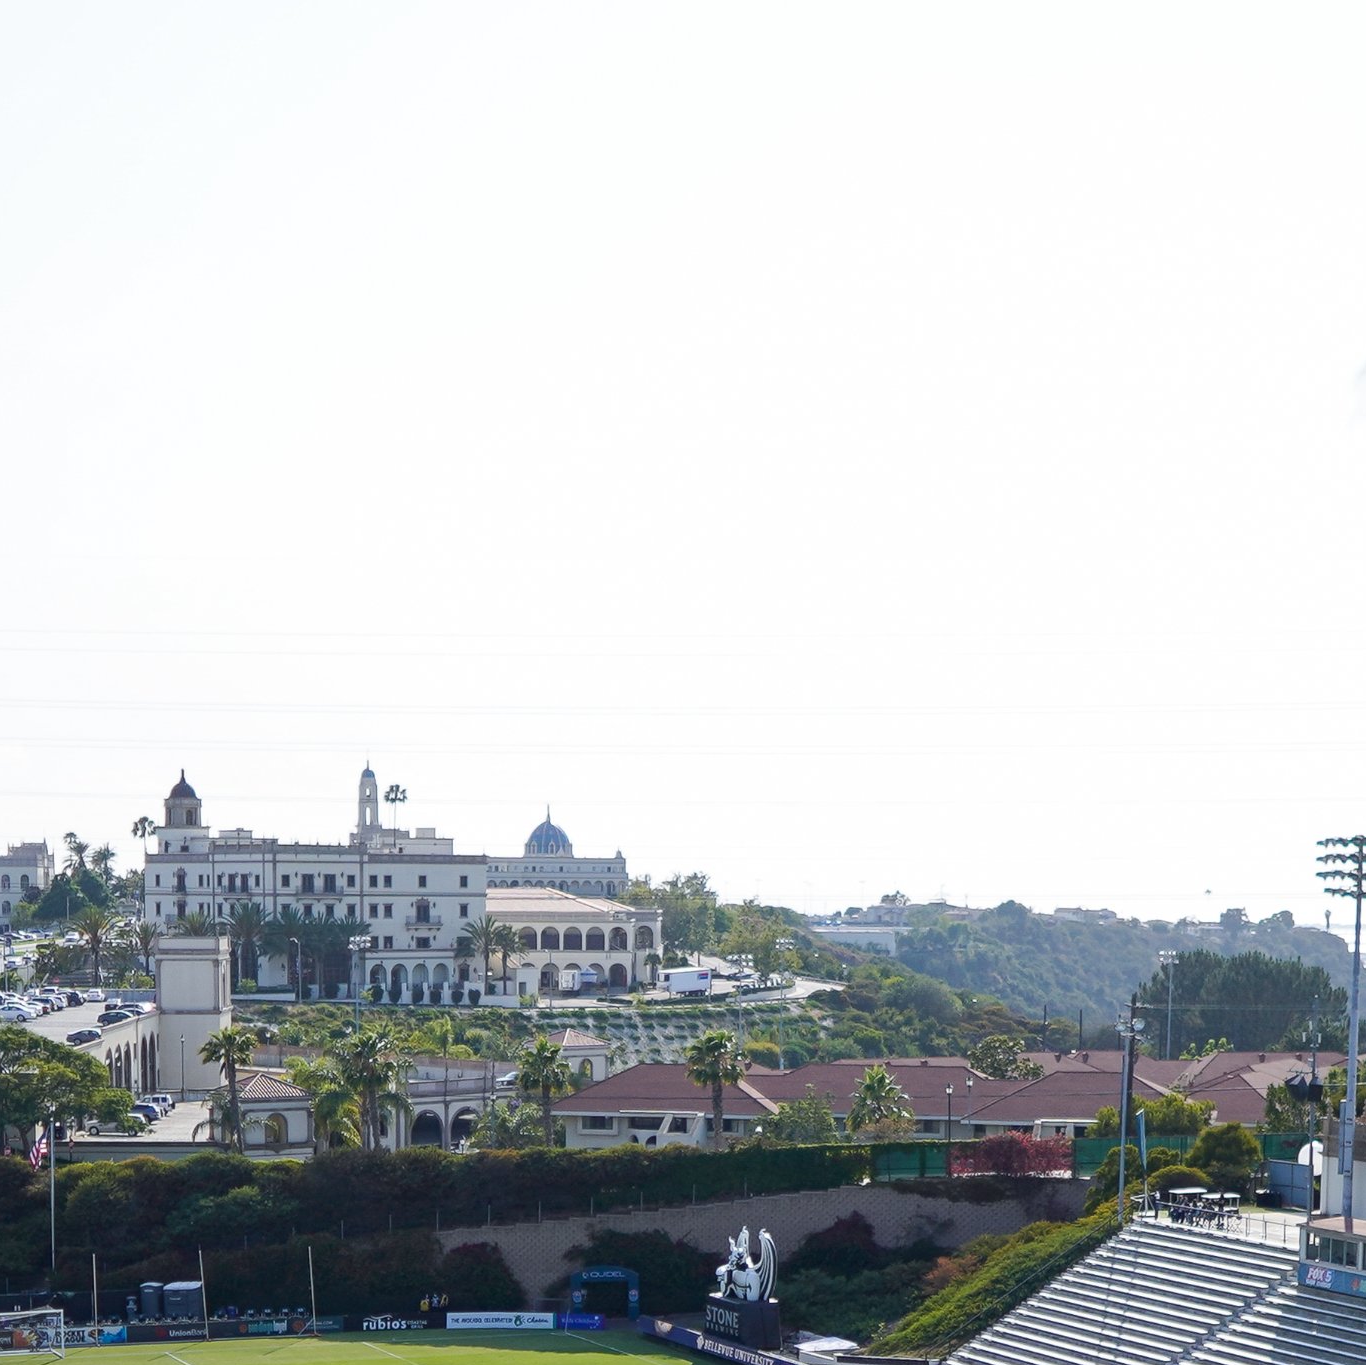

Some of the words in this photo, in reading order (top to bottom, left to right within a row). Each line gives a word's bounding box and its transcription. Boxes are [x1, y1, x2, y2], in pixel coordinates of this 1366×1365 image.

[1308, 1267, 1325, 1281] FOX
[1325, 1271, 1333, 1283] 5
[363, 1314, 406, 1331] rubio's
[706, 1305, 739, 1329] STONE
[706, 1322, 739, 1337] BREWING
[704, 1340, 733, 1358] BELLEVUE
